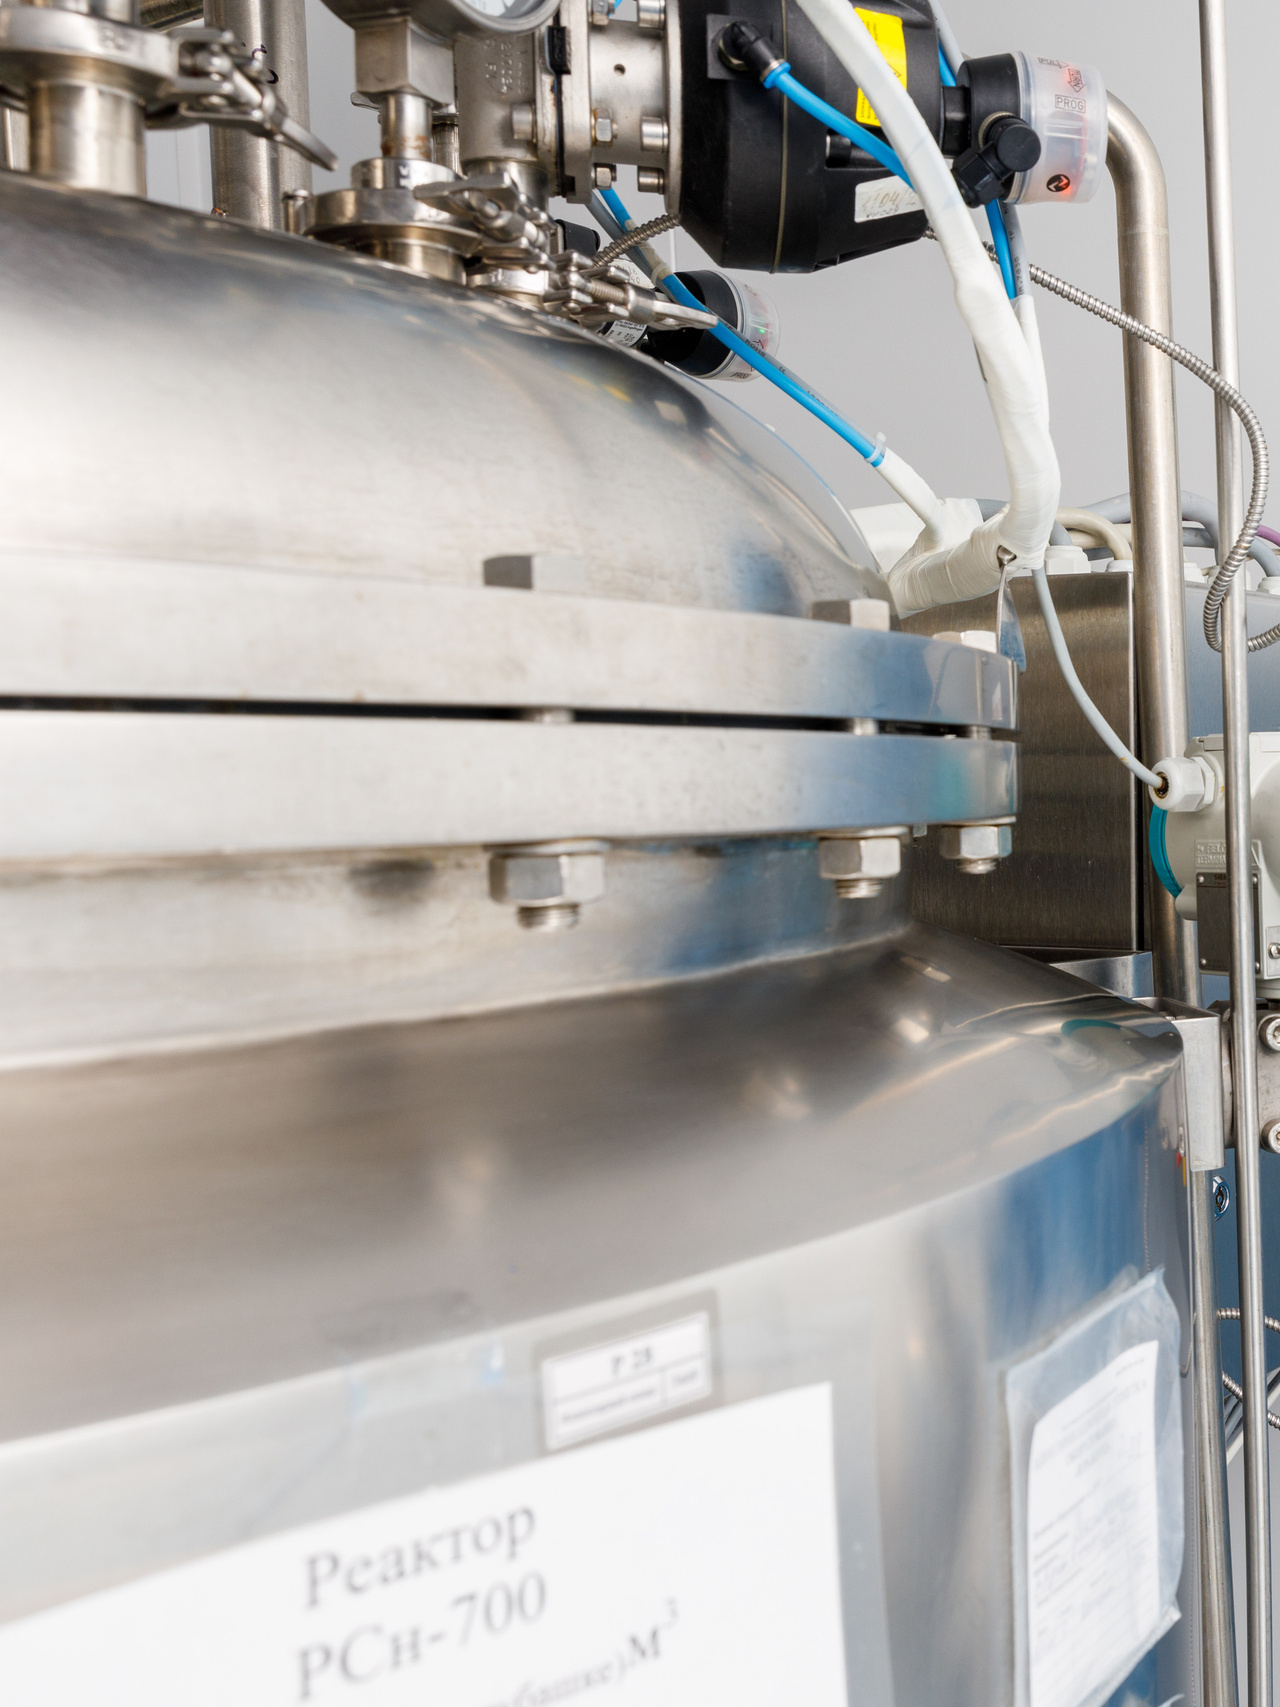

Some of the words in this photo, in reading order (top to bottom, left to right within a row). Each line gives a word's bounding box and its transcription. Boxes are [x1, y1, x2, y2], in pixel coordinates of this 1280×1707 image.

[1056, 96, 1085, 111] PROG
[1196, 854, 1226, 865] TERMINA
[304, 1505, 537, 1610] Реактор
[296, 1570, 547, 1703] РСн-700
